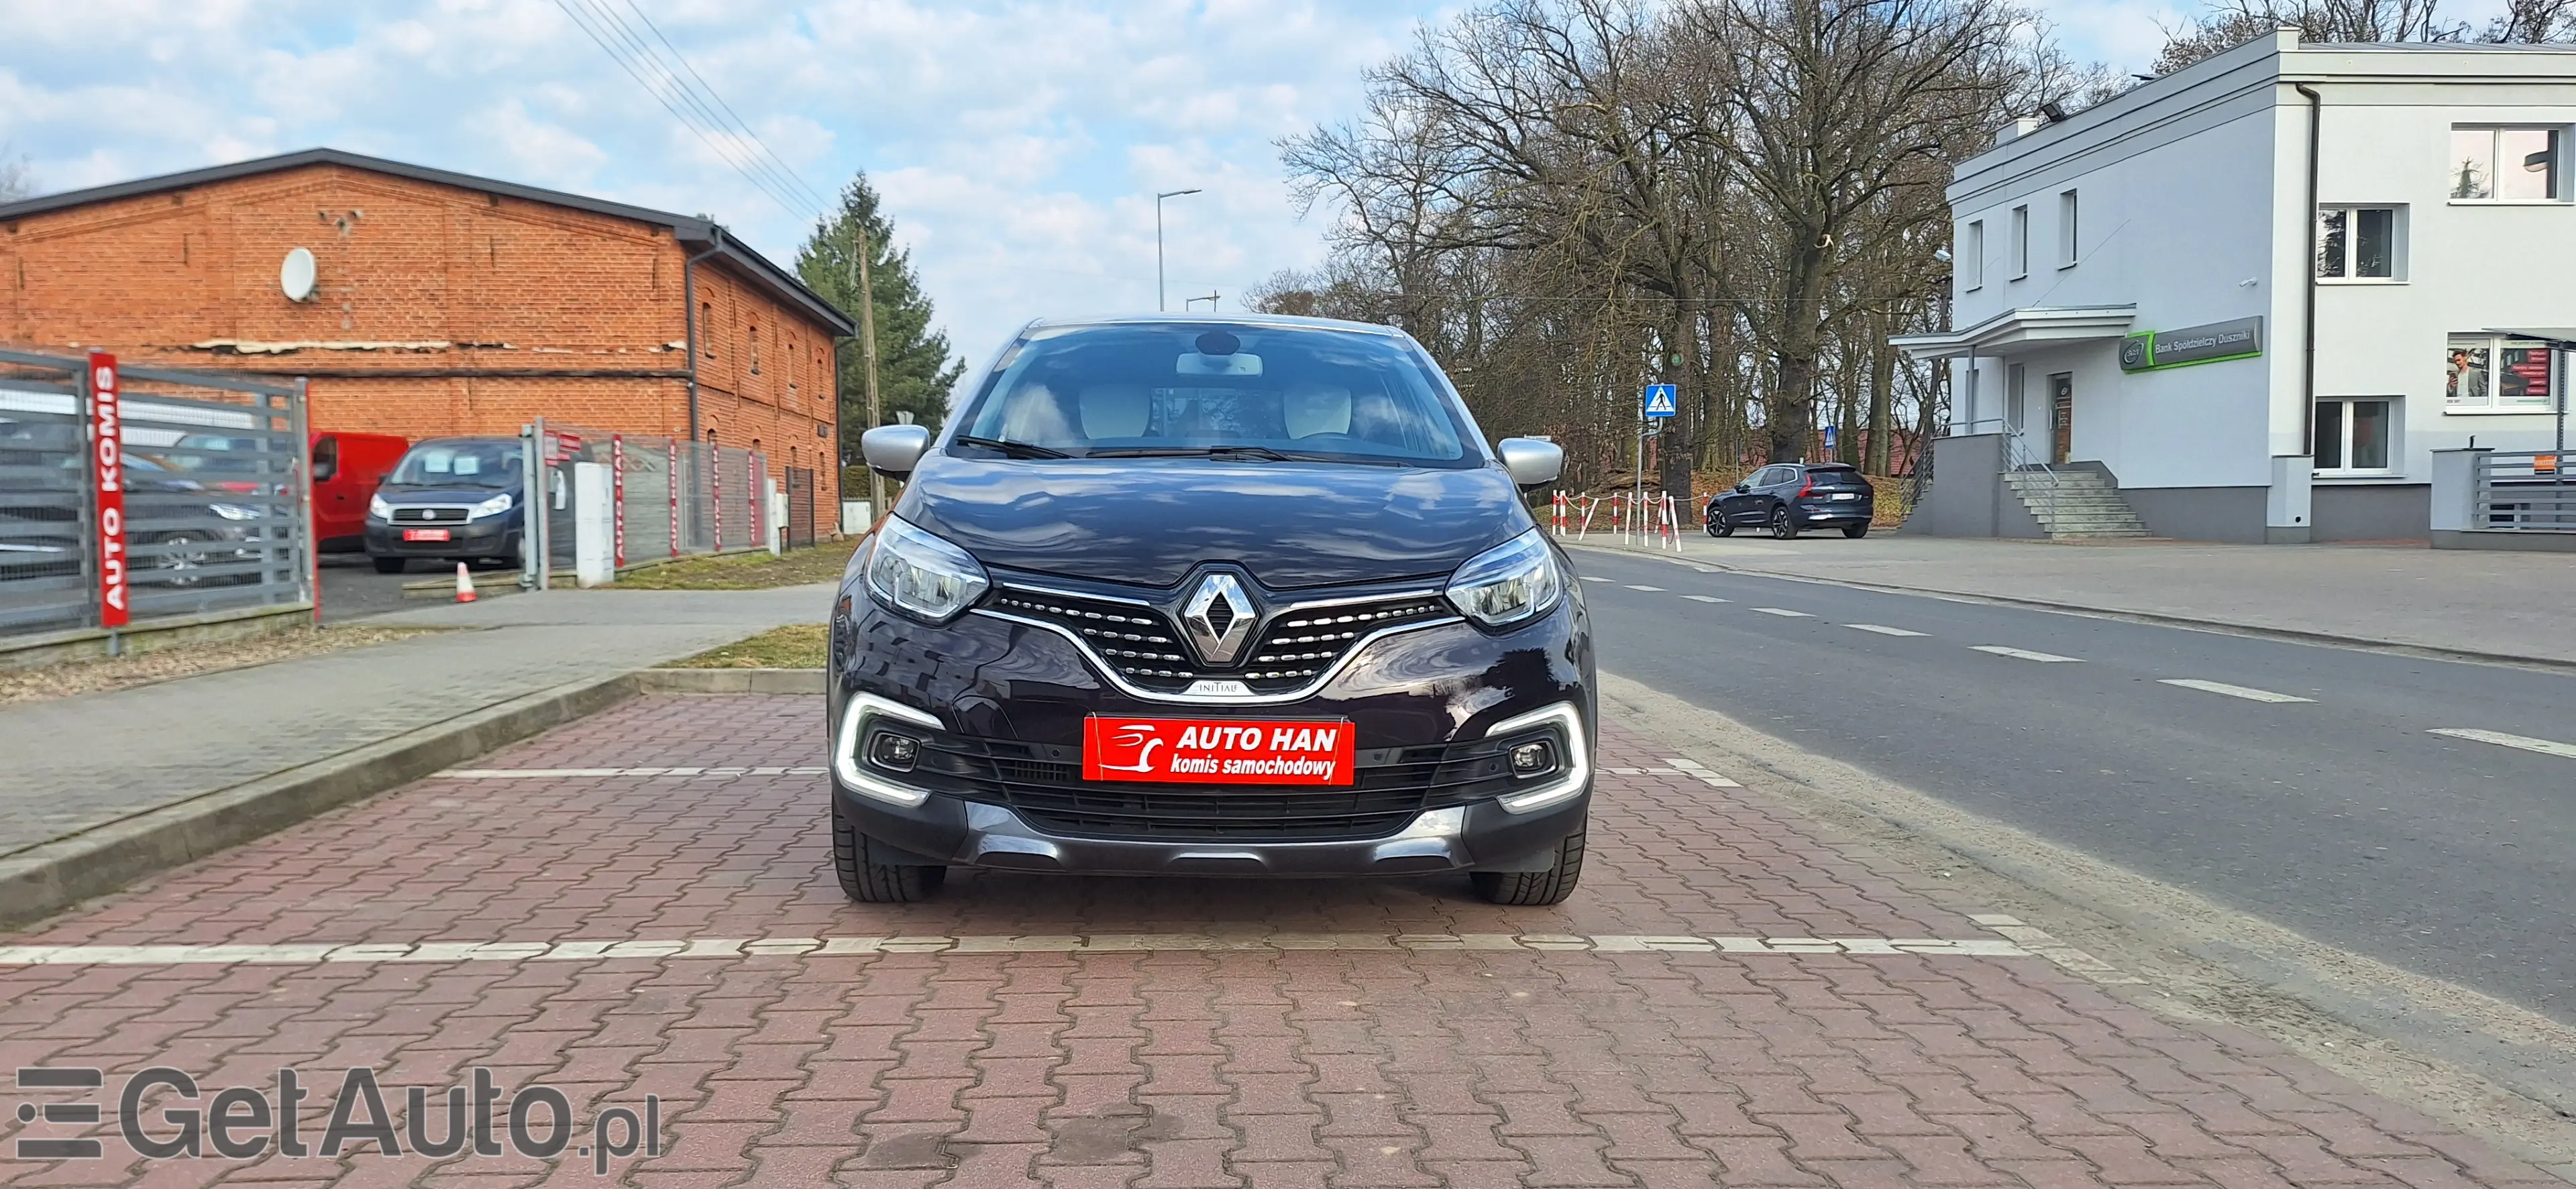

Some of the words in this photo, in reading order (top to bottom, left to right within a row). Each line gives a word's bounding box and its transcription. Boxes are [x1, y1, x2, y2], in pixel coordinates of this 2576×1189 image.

[2155, 343, 2172, 354] Bank
[2174, 336, 2216, 353] Spółdzielczy
[2218, 330, 2250, 344] Duszniki
[95, 366, 119, 492] KOMIS
[103, 507, 125, 611] AUTO
[1199, 682, 1238, 692] INITIALE
[1176, 726, 1263, 751] AUTO
[1270, 728, 1338, 752] HAN
[1170, 752, 1219, 774] komis
[1222, 754, 1337, 781] samochodowy
